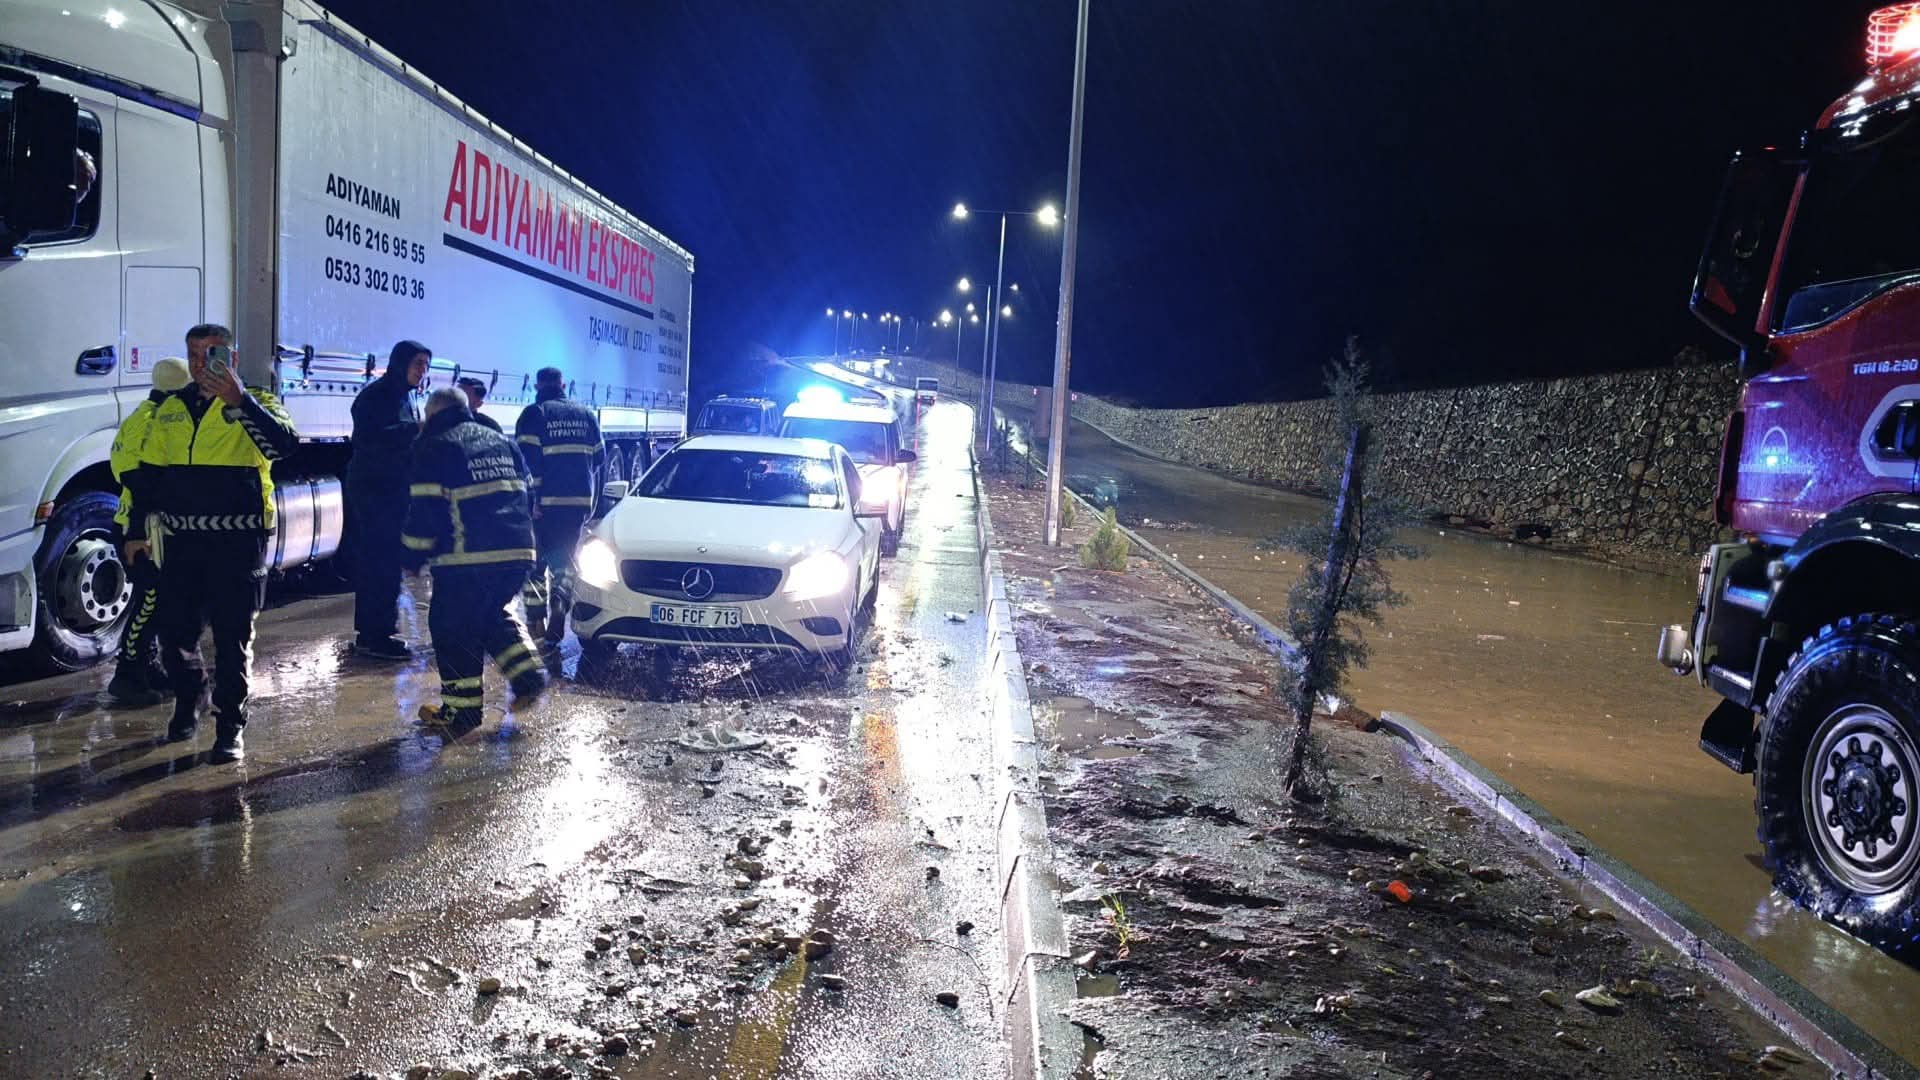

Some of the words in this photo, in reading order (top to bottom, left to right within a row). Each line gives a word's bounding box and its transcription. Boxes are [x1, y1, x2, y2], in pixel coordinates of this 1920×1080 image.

[325, 172, 401, 220] ADIYAMAN
[325, 214, 361, 246] 0416
[365, 227, 389, 254] 216
[393, 236, 408, 260] 95
[411, 242, 425, 265] 55
[443, 139, 585, 276] ADIYAMAN
[586, 219, 656, 305] EKSPRES
[325, 256, 360, 286] 0533
[364, 266, 389, 292] 302
[392, 273, 407, 297] 03
[410, 278, 425, 301] 36
[660, 607, 674, 622] 06
[682, 608, 706, 624] FCF
[714, 610, 738, 625] 713
